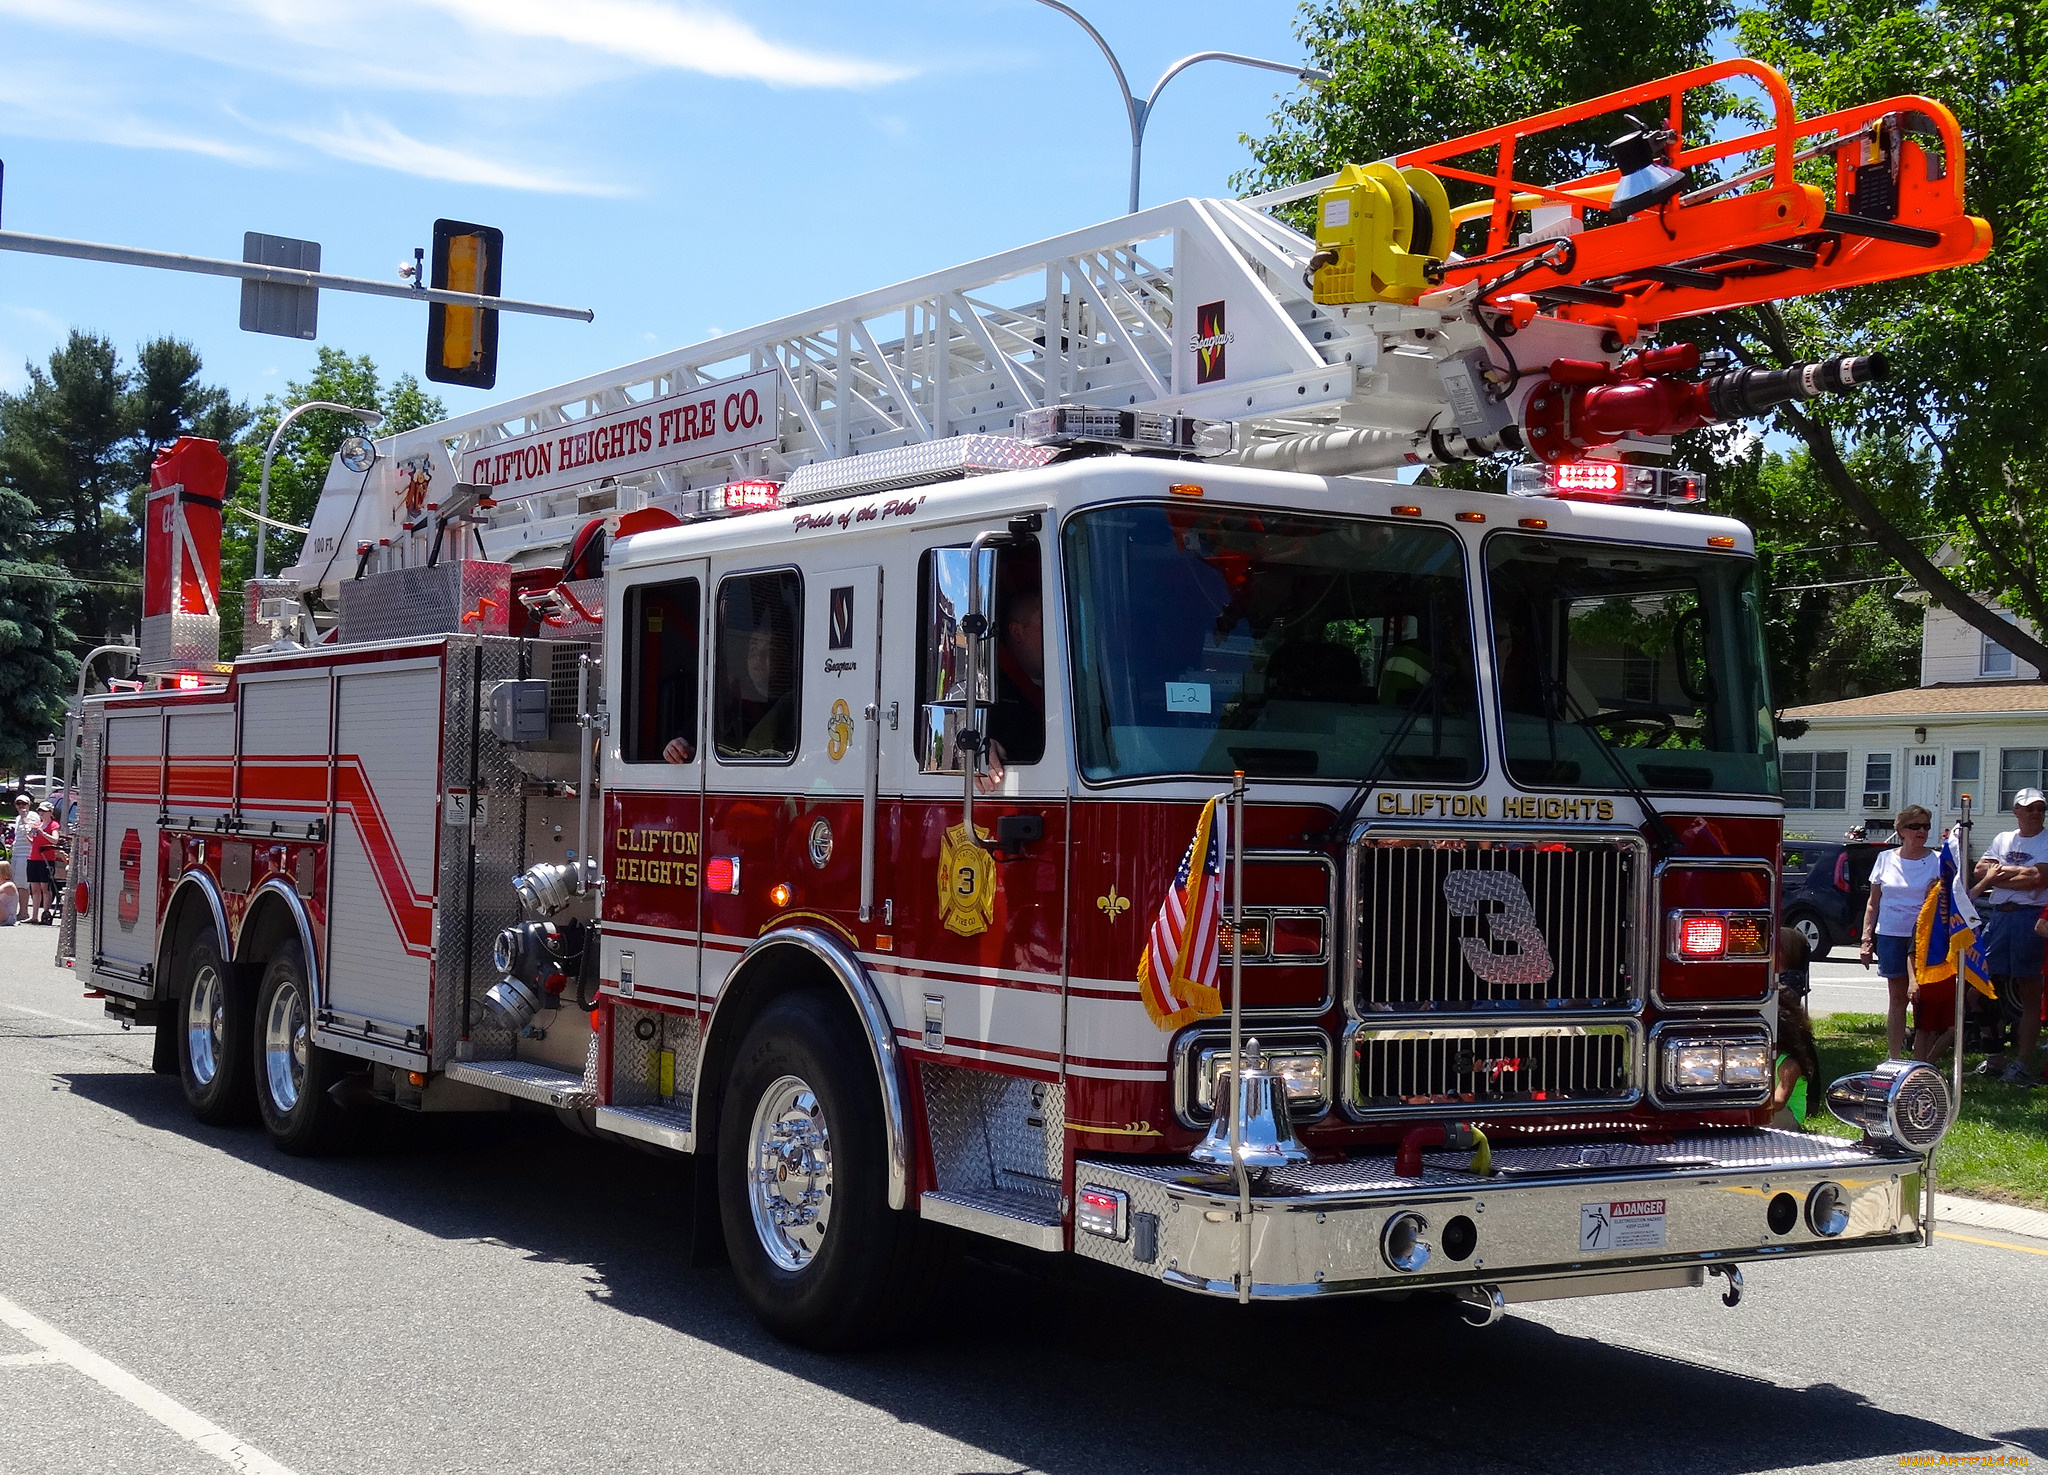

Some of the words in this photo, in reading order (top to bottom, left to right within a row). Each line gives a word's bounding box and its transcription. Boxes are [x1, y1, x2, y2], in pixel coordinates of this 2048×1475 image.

[1189, 332, 1235, 355] Seagrave
[472, 441, 553, 487] CLIFTON
[558, 415, 652, 471] HEIGHTS
[658, 399, 715, 448] FIRE
[723, 388, 763, 432] CO.
[837, 507, 855, 530] of
[856, 503, 877, 522] the
[1377, 793, 1488, 817] CLIFTON
[1502, 796, 1615, 820] HEIGHTS
[616, 828, 699, 855] CLIFTON
[616, 857, 698, 887] HEIGHTS
[958, 866, 975, 895] 3
[955, 914, 968, 926] FIRE
[1443, 869, 1555, 984] 3
[1623, 1202, 1664, 1215] DANGER
